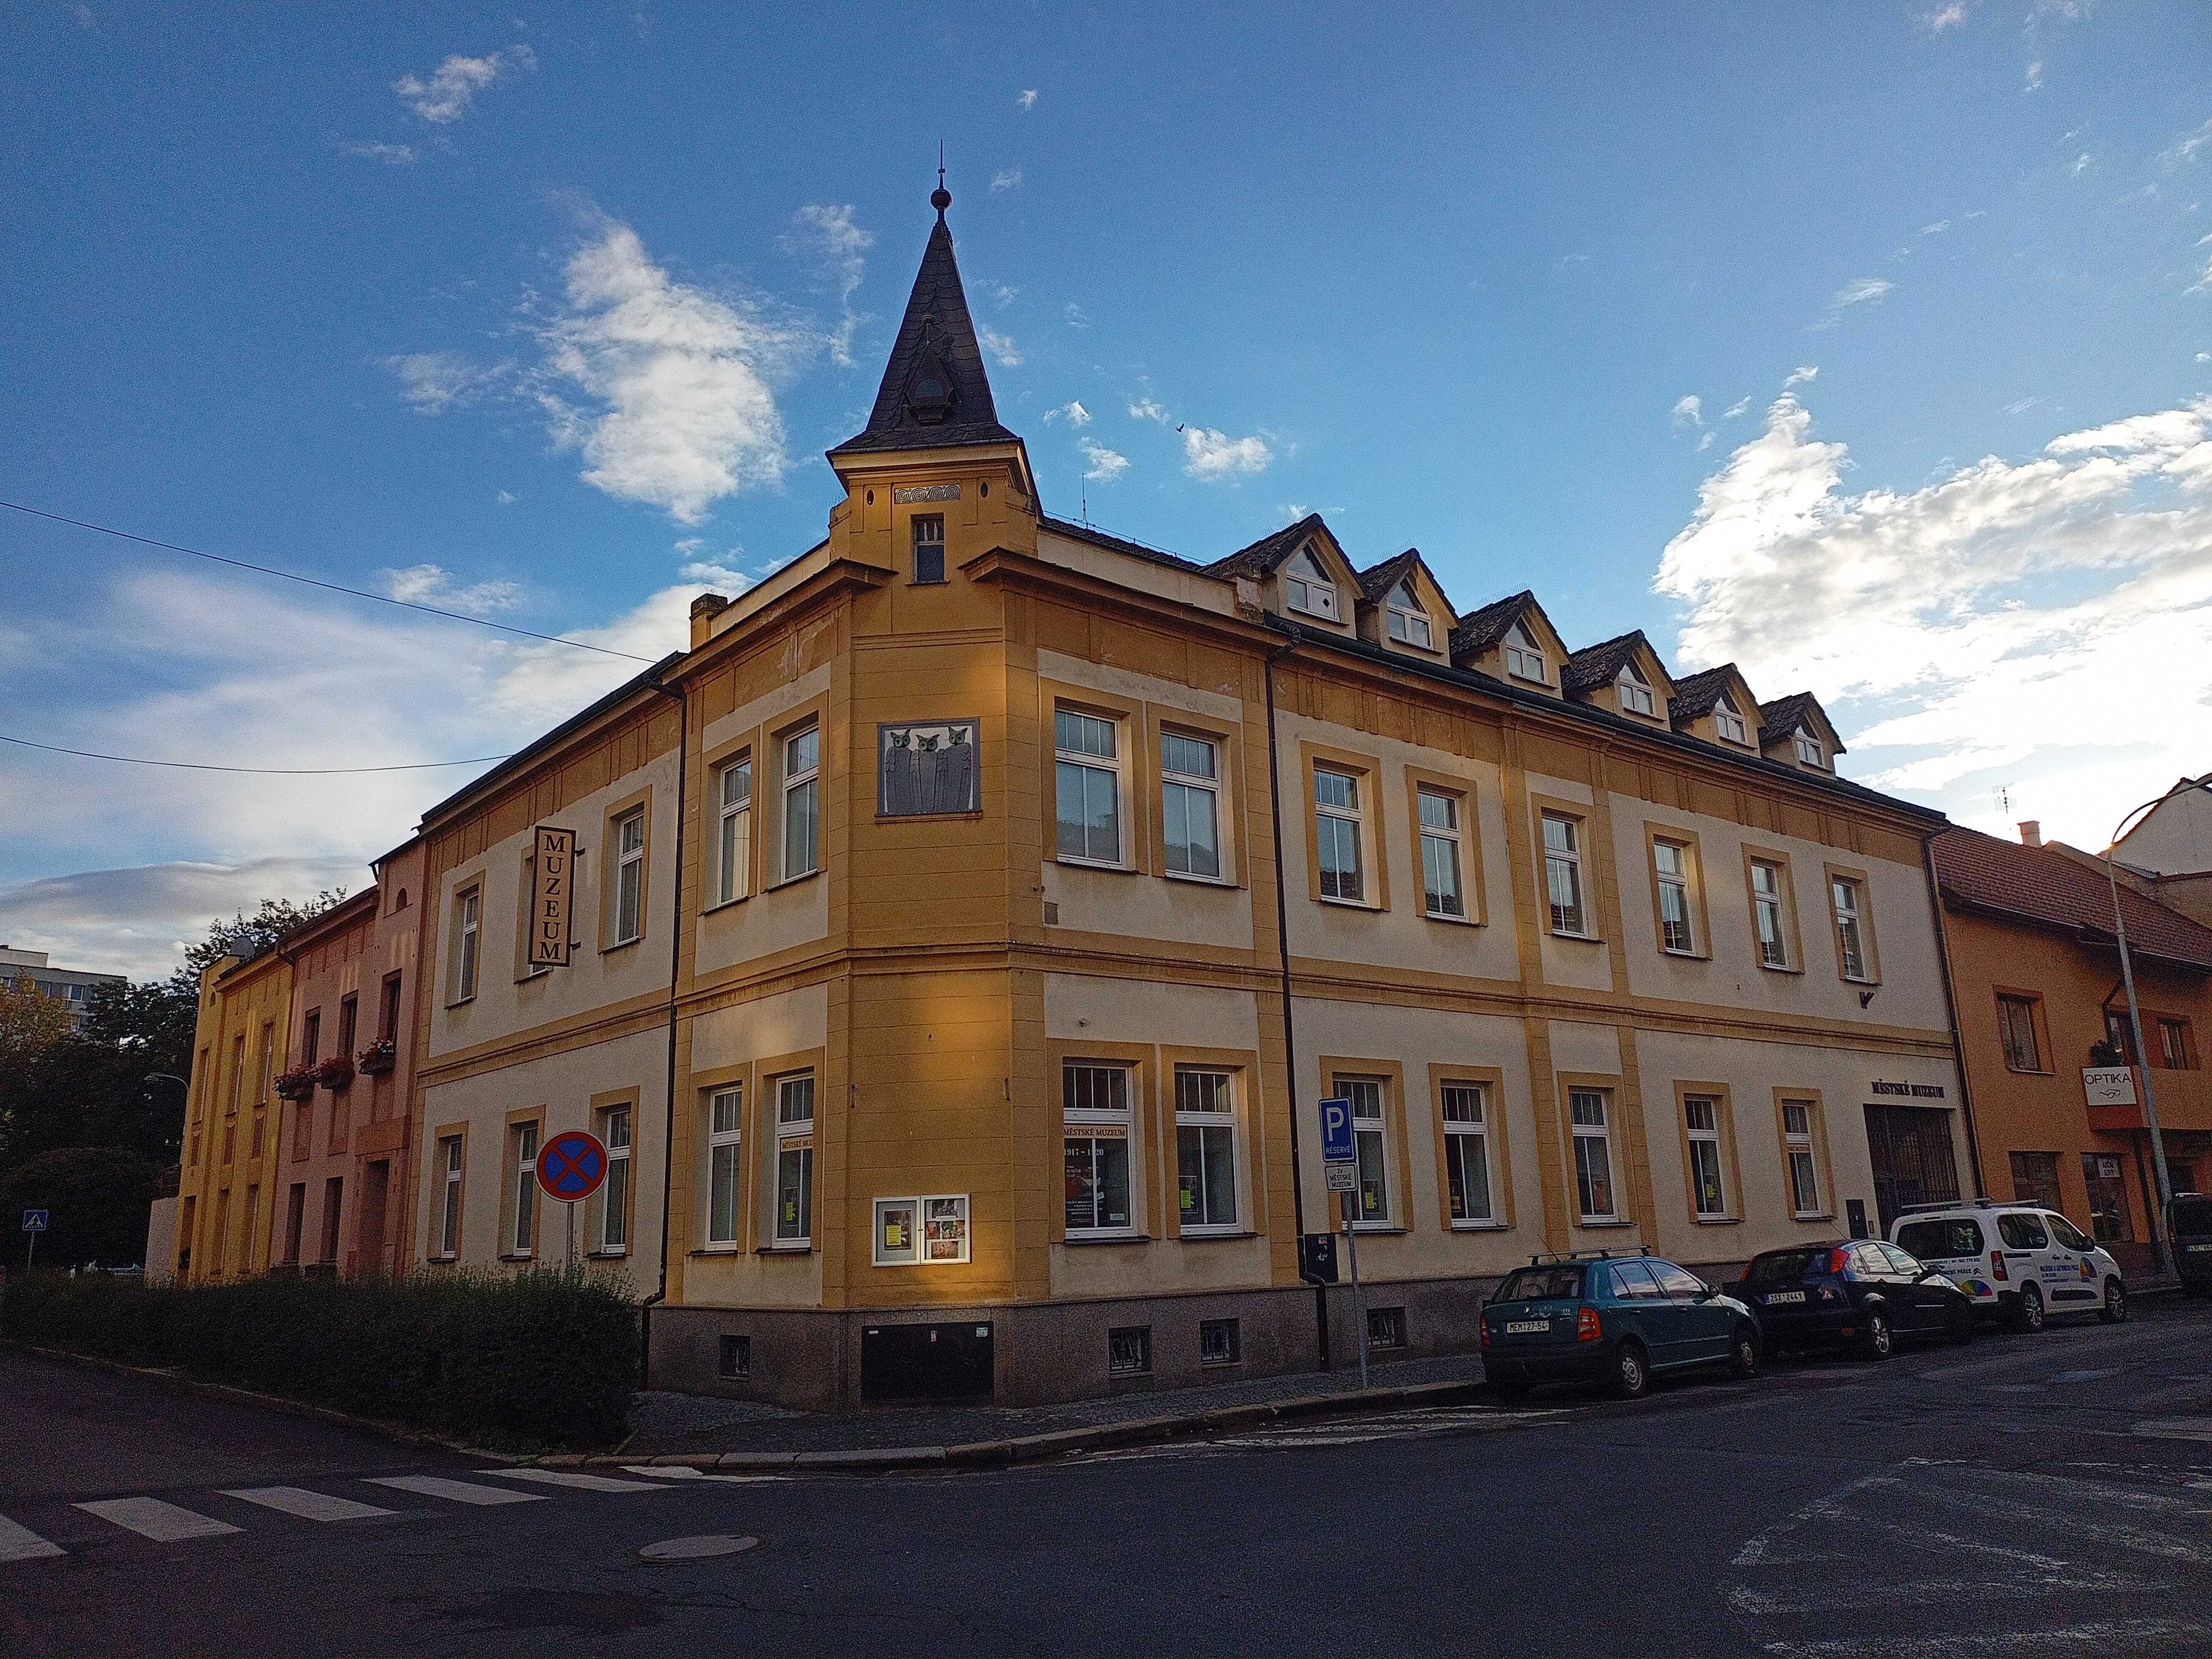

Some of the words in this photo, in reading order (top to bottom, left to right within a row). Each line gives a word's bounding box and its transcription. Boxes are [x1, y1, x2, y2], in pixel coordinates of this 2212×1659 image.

[539, 834, 566, 959] MUZEUM
[2085, 1073, 2132, 1084] OPTIKA
[1871, 1079, 1910, 1095] MĚSTSKÉ
[1911, 1085, 1944, 1098] MUZEUM
[1326, 1107, 1344, 1141] P
[1064, 1128, 1094, 1136] MĚSTSKÉ
[782, 1140, 801, 1149] MĚSTSKÉ
[1326, 1144, 1351, 1154] RÉSERVÉ
[1087, 1148, 1104, 1156] 120
[1330, 1173, 1352, 1181] MĚSTSKÉ
[1786, 1292, 1802, 1301] 2441
[1510, 1323, 1522, 1332] MEM
[1527, 1322, 1546, 1331] 27-54
